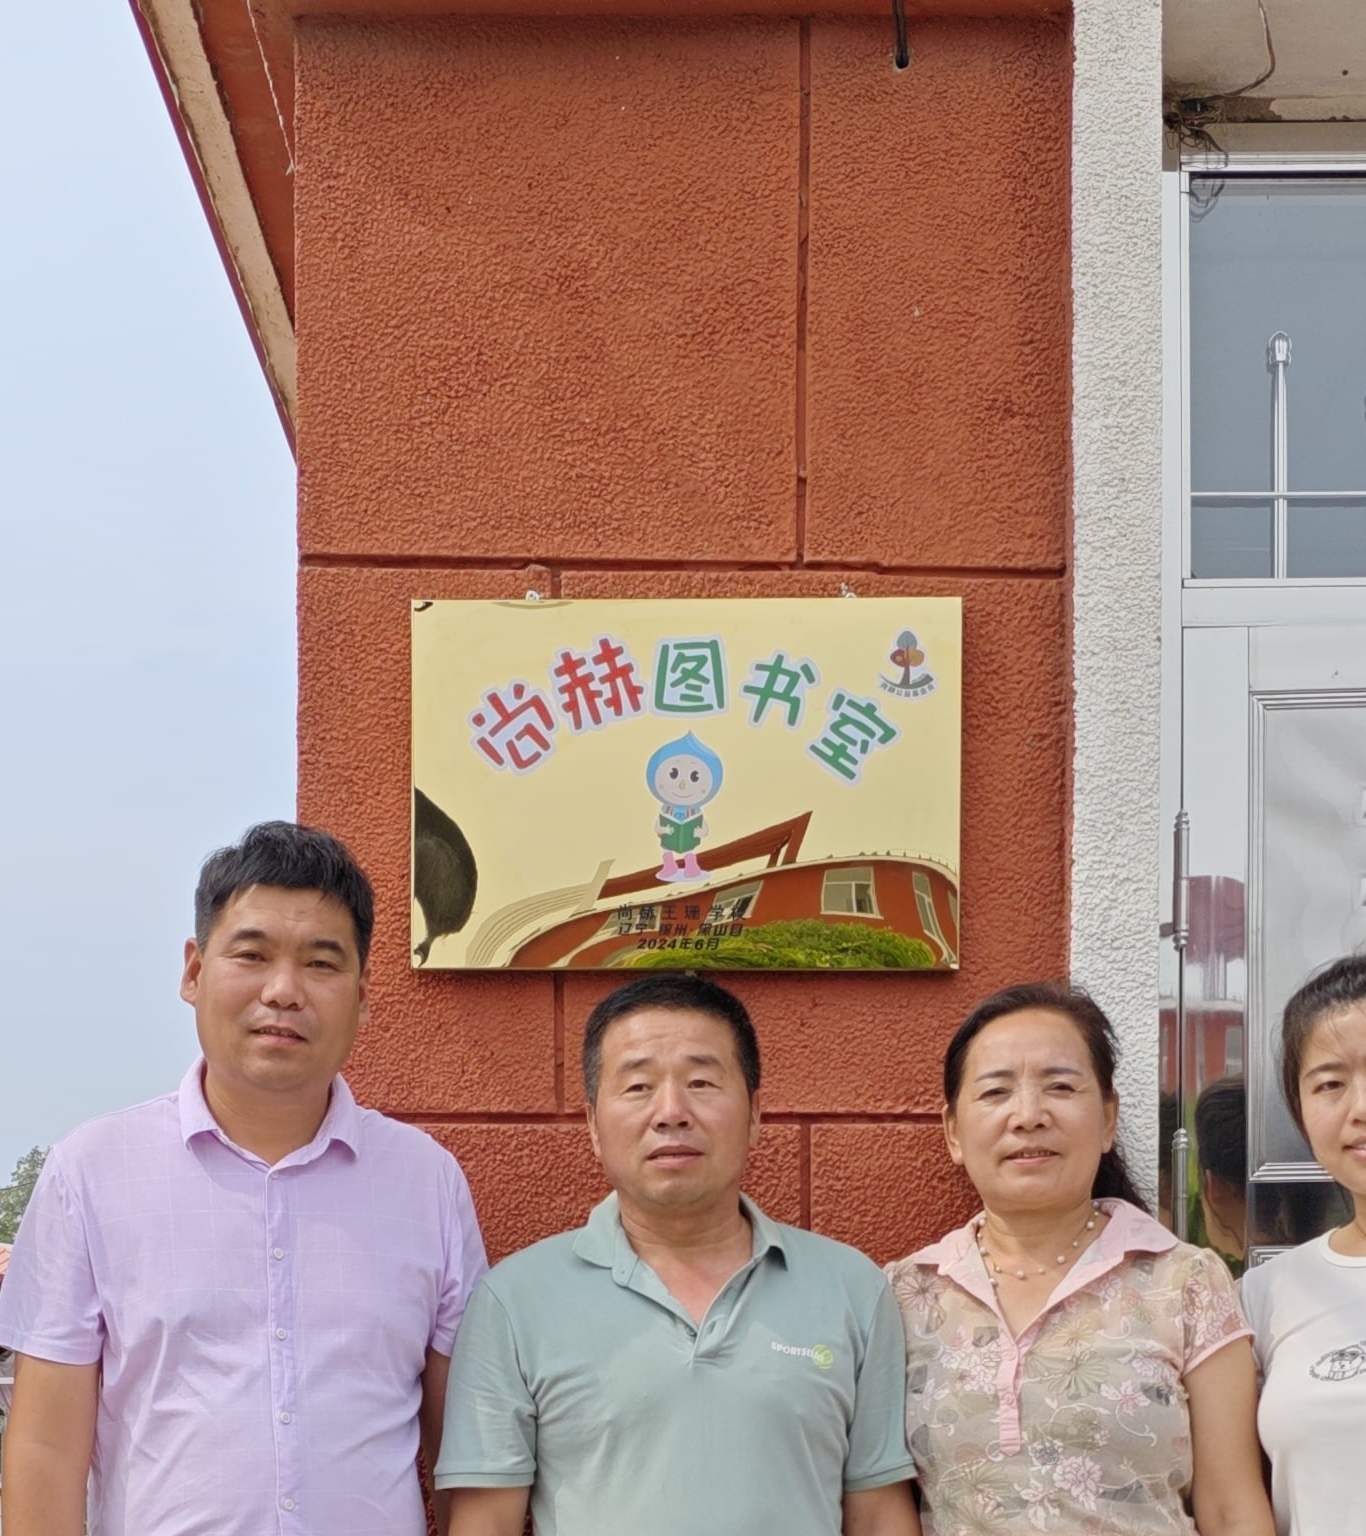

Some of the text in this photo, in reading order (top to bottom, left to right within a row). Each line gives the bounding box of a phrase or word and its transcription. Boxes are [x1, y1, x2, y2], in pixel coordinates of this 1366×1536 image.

[472, 638, 897, 781] 尚赫图书室
[636, 938, 720, 950] 2024年6月
